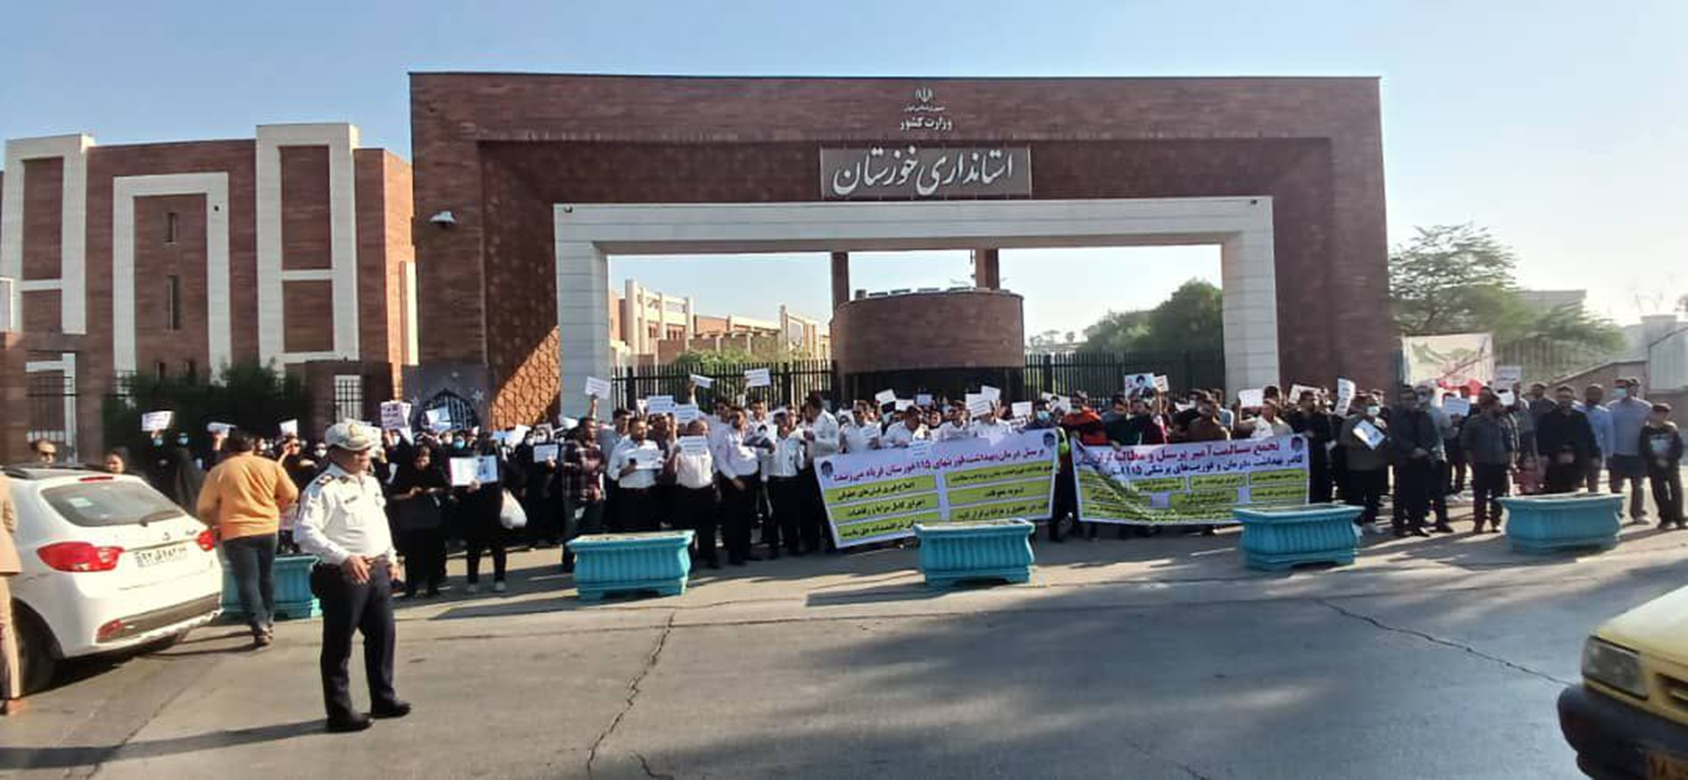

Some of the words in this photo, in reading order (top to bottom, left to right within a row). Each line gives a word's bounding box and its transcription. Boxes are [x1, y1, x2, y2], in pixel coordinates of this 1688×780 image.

[900, 117, 924, 131] کشور
[924, 116, 952, 131] وزارت
[832, 145, 918, 195] خوزستان
[916, 149, 1013, 196] استانداری
